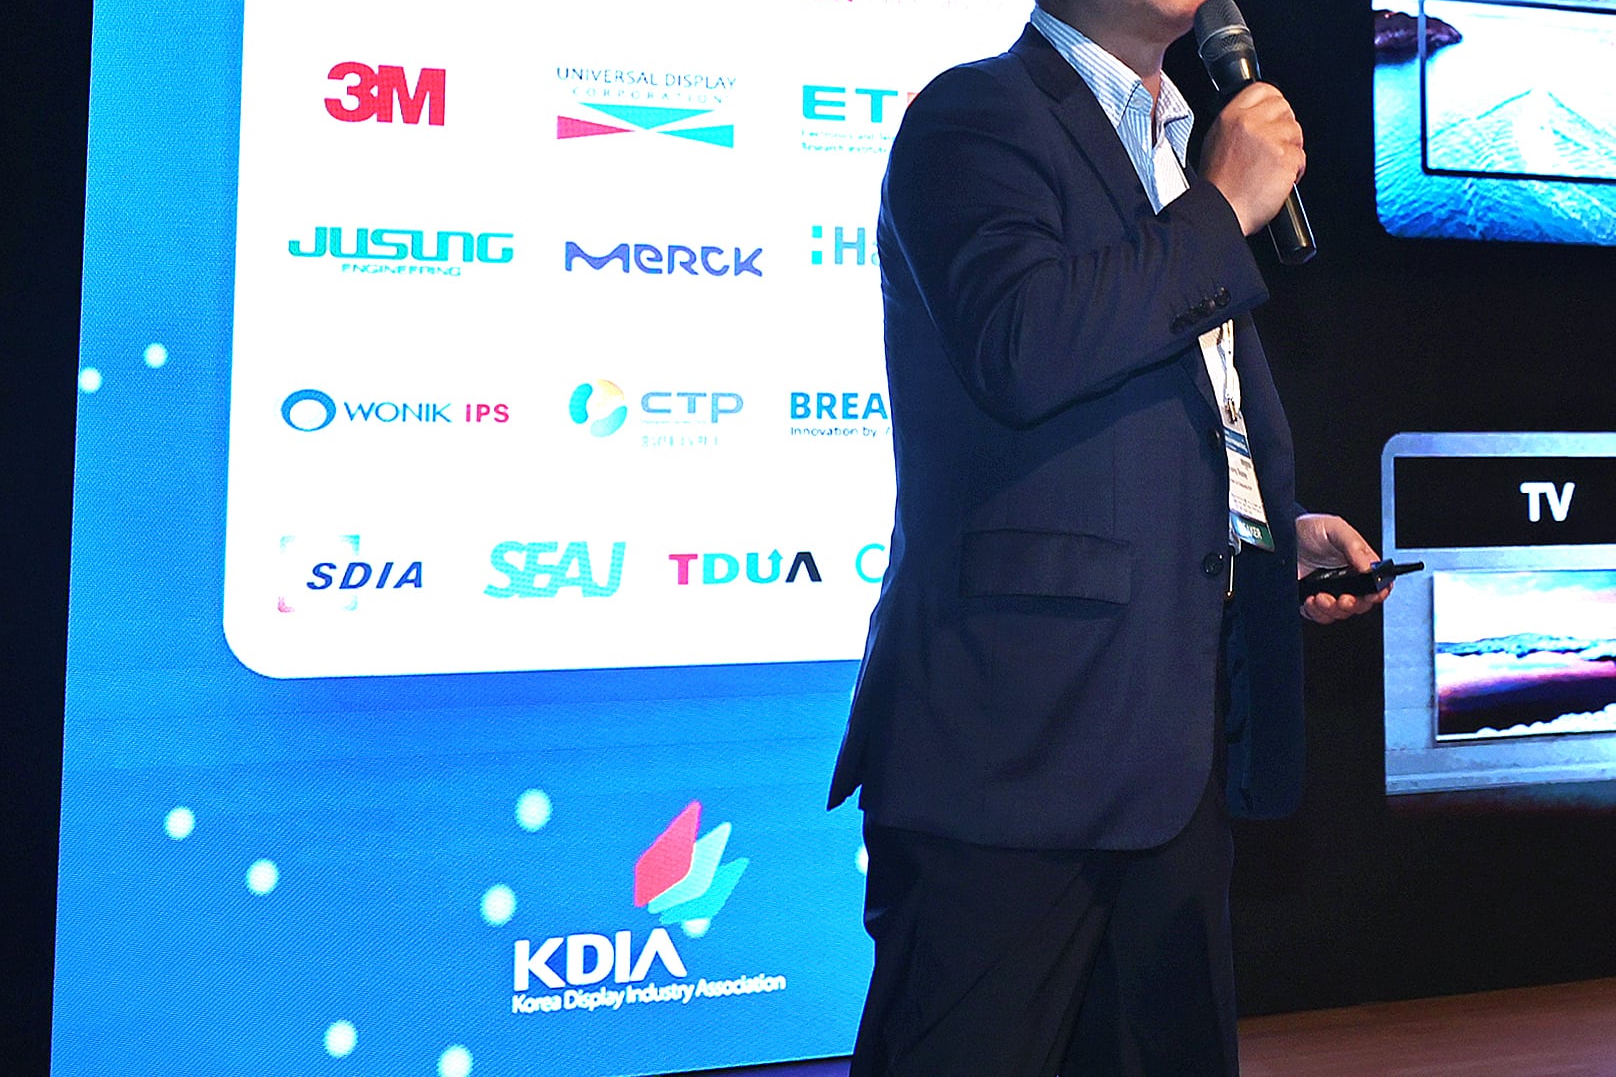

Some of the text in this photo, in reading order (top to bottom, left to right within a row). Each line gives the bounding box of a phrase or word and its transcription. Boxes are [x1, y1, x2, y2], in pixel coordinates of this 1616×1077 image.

[557, 67, 736, 90] UNIVERSAL DISPLAY
[324, 61, 446, 126] 3M
[573, 87, 723, 103] CORPORATION
[803, 85, 920, 123] ET
[342, 264, 461, 276] ENGINEERING
[345, 401, 509, 424] WONIK IPS
[791, 426, 877, 438] Innovation by
[1520, 482, 1576, 522] TV
[306, 561, 425, 589] SDIA
[514, 927, 687, 992] KDIA
[512, 973, 786, 1014] Korea Display Industry Association
